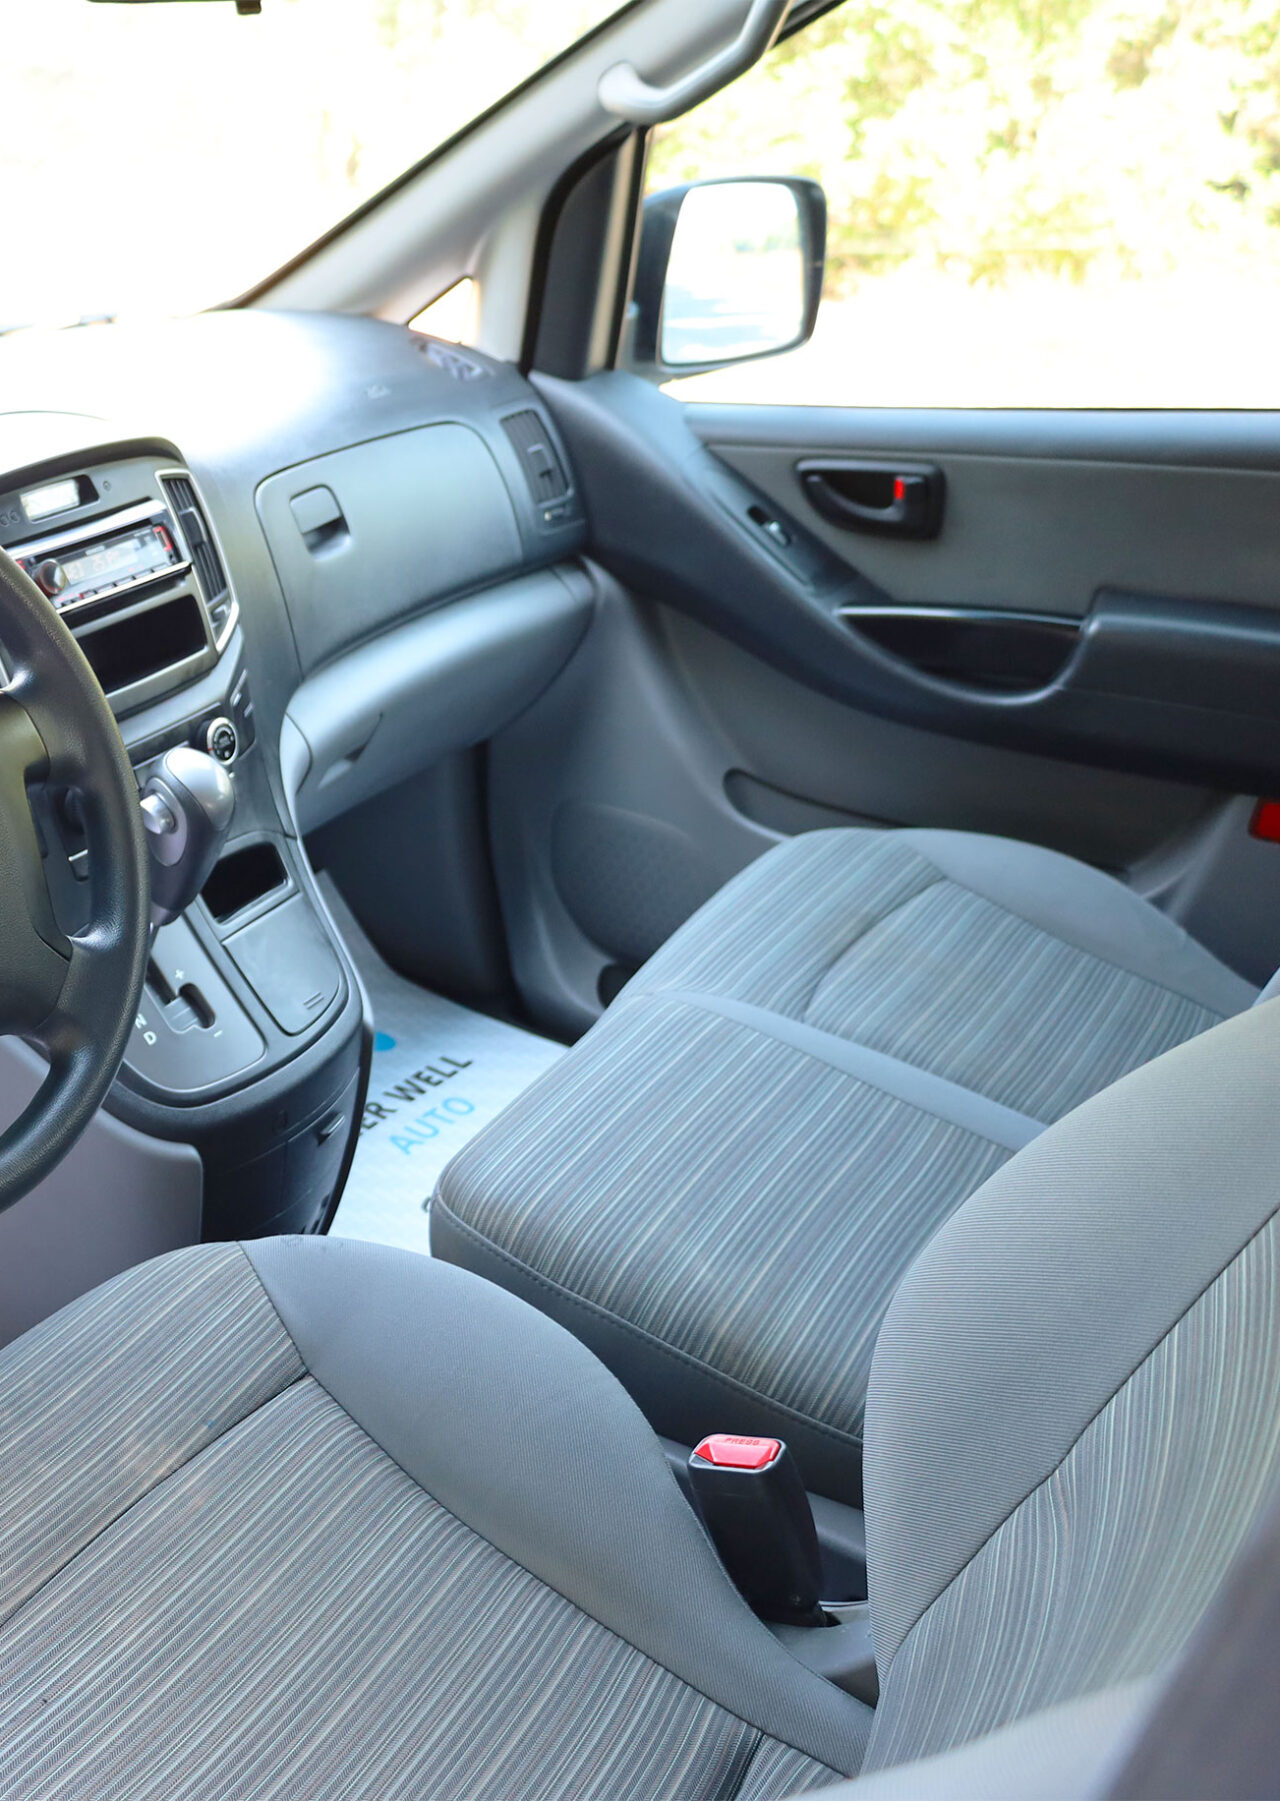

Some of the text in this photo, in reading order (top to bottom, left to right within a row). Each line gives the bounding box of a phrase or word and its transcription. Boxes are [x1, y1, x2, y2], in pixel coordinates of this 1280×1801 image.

[143, 1031, 158, 1046] D
[382, 1055, 474, 1102] WELL
[388, 1097, 476, 1156] AUTO
